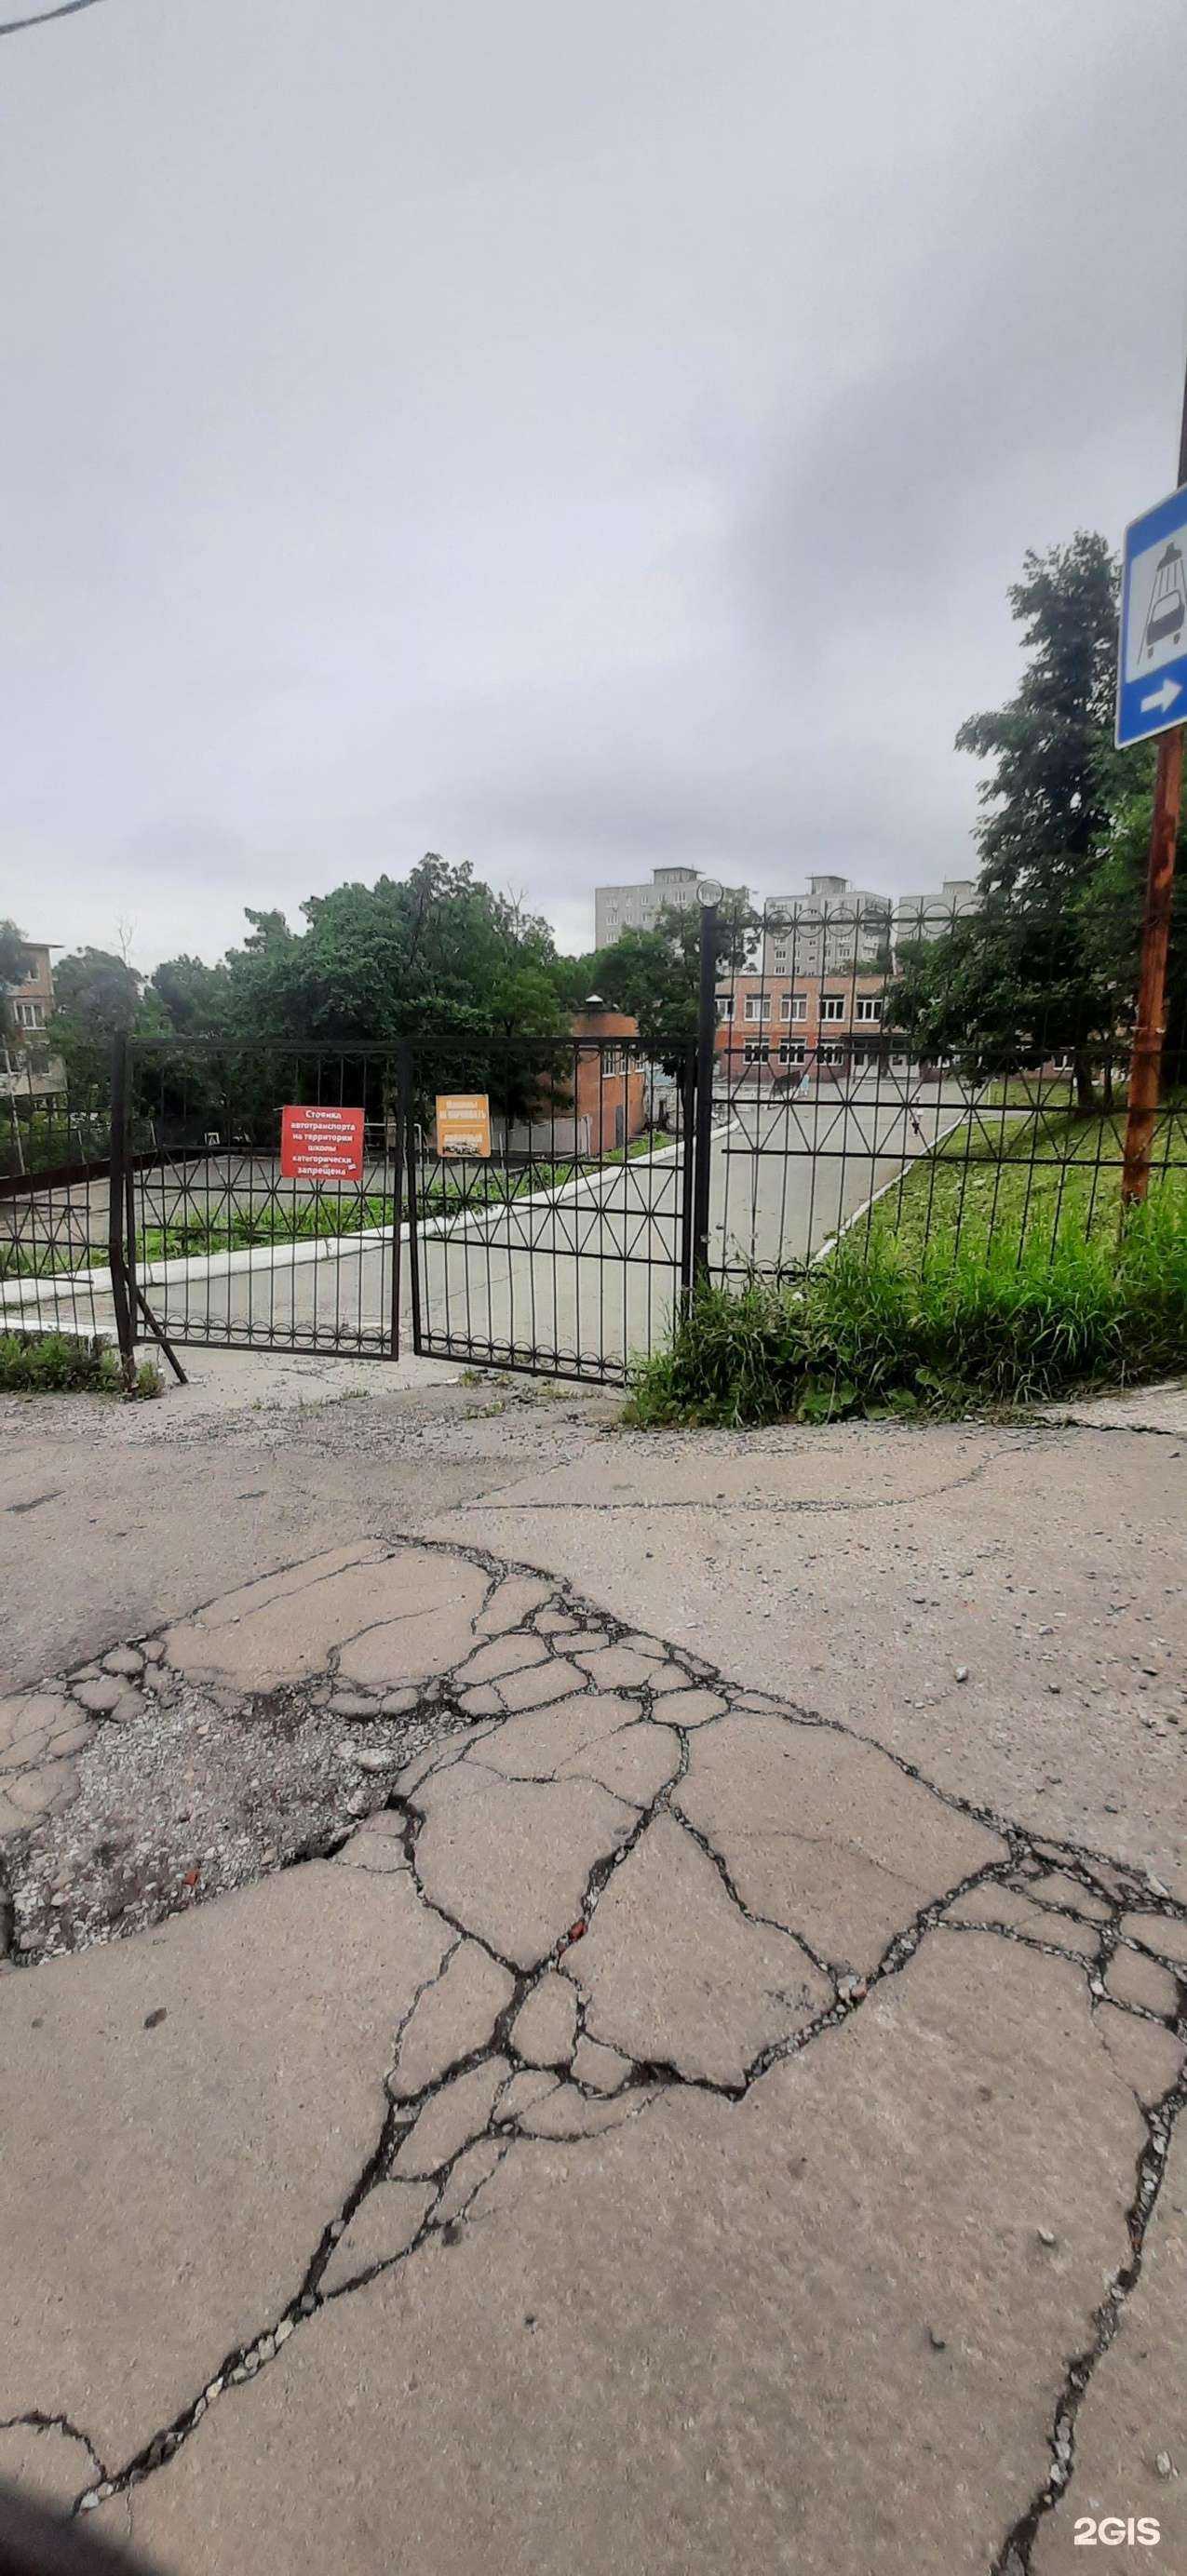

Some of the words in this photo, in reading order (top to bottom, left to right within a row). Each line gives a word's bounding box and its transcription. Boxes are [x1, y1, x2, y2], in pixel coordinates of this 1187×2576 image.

[305, 1109, 342, 1120] Стоянка
[290, 1121, 356, 1132] автотранспорта
[304, 1134, 353, 1142] территории
[292, 1156, 352, 1164] категорически
[298, 1166, 346, 1175] запрещена
